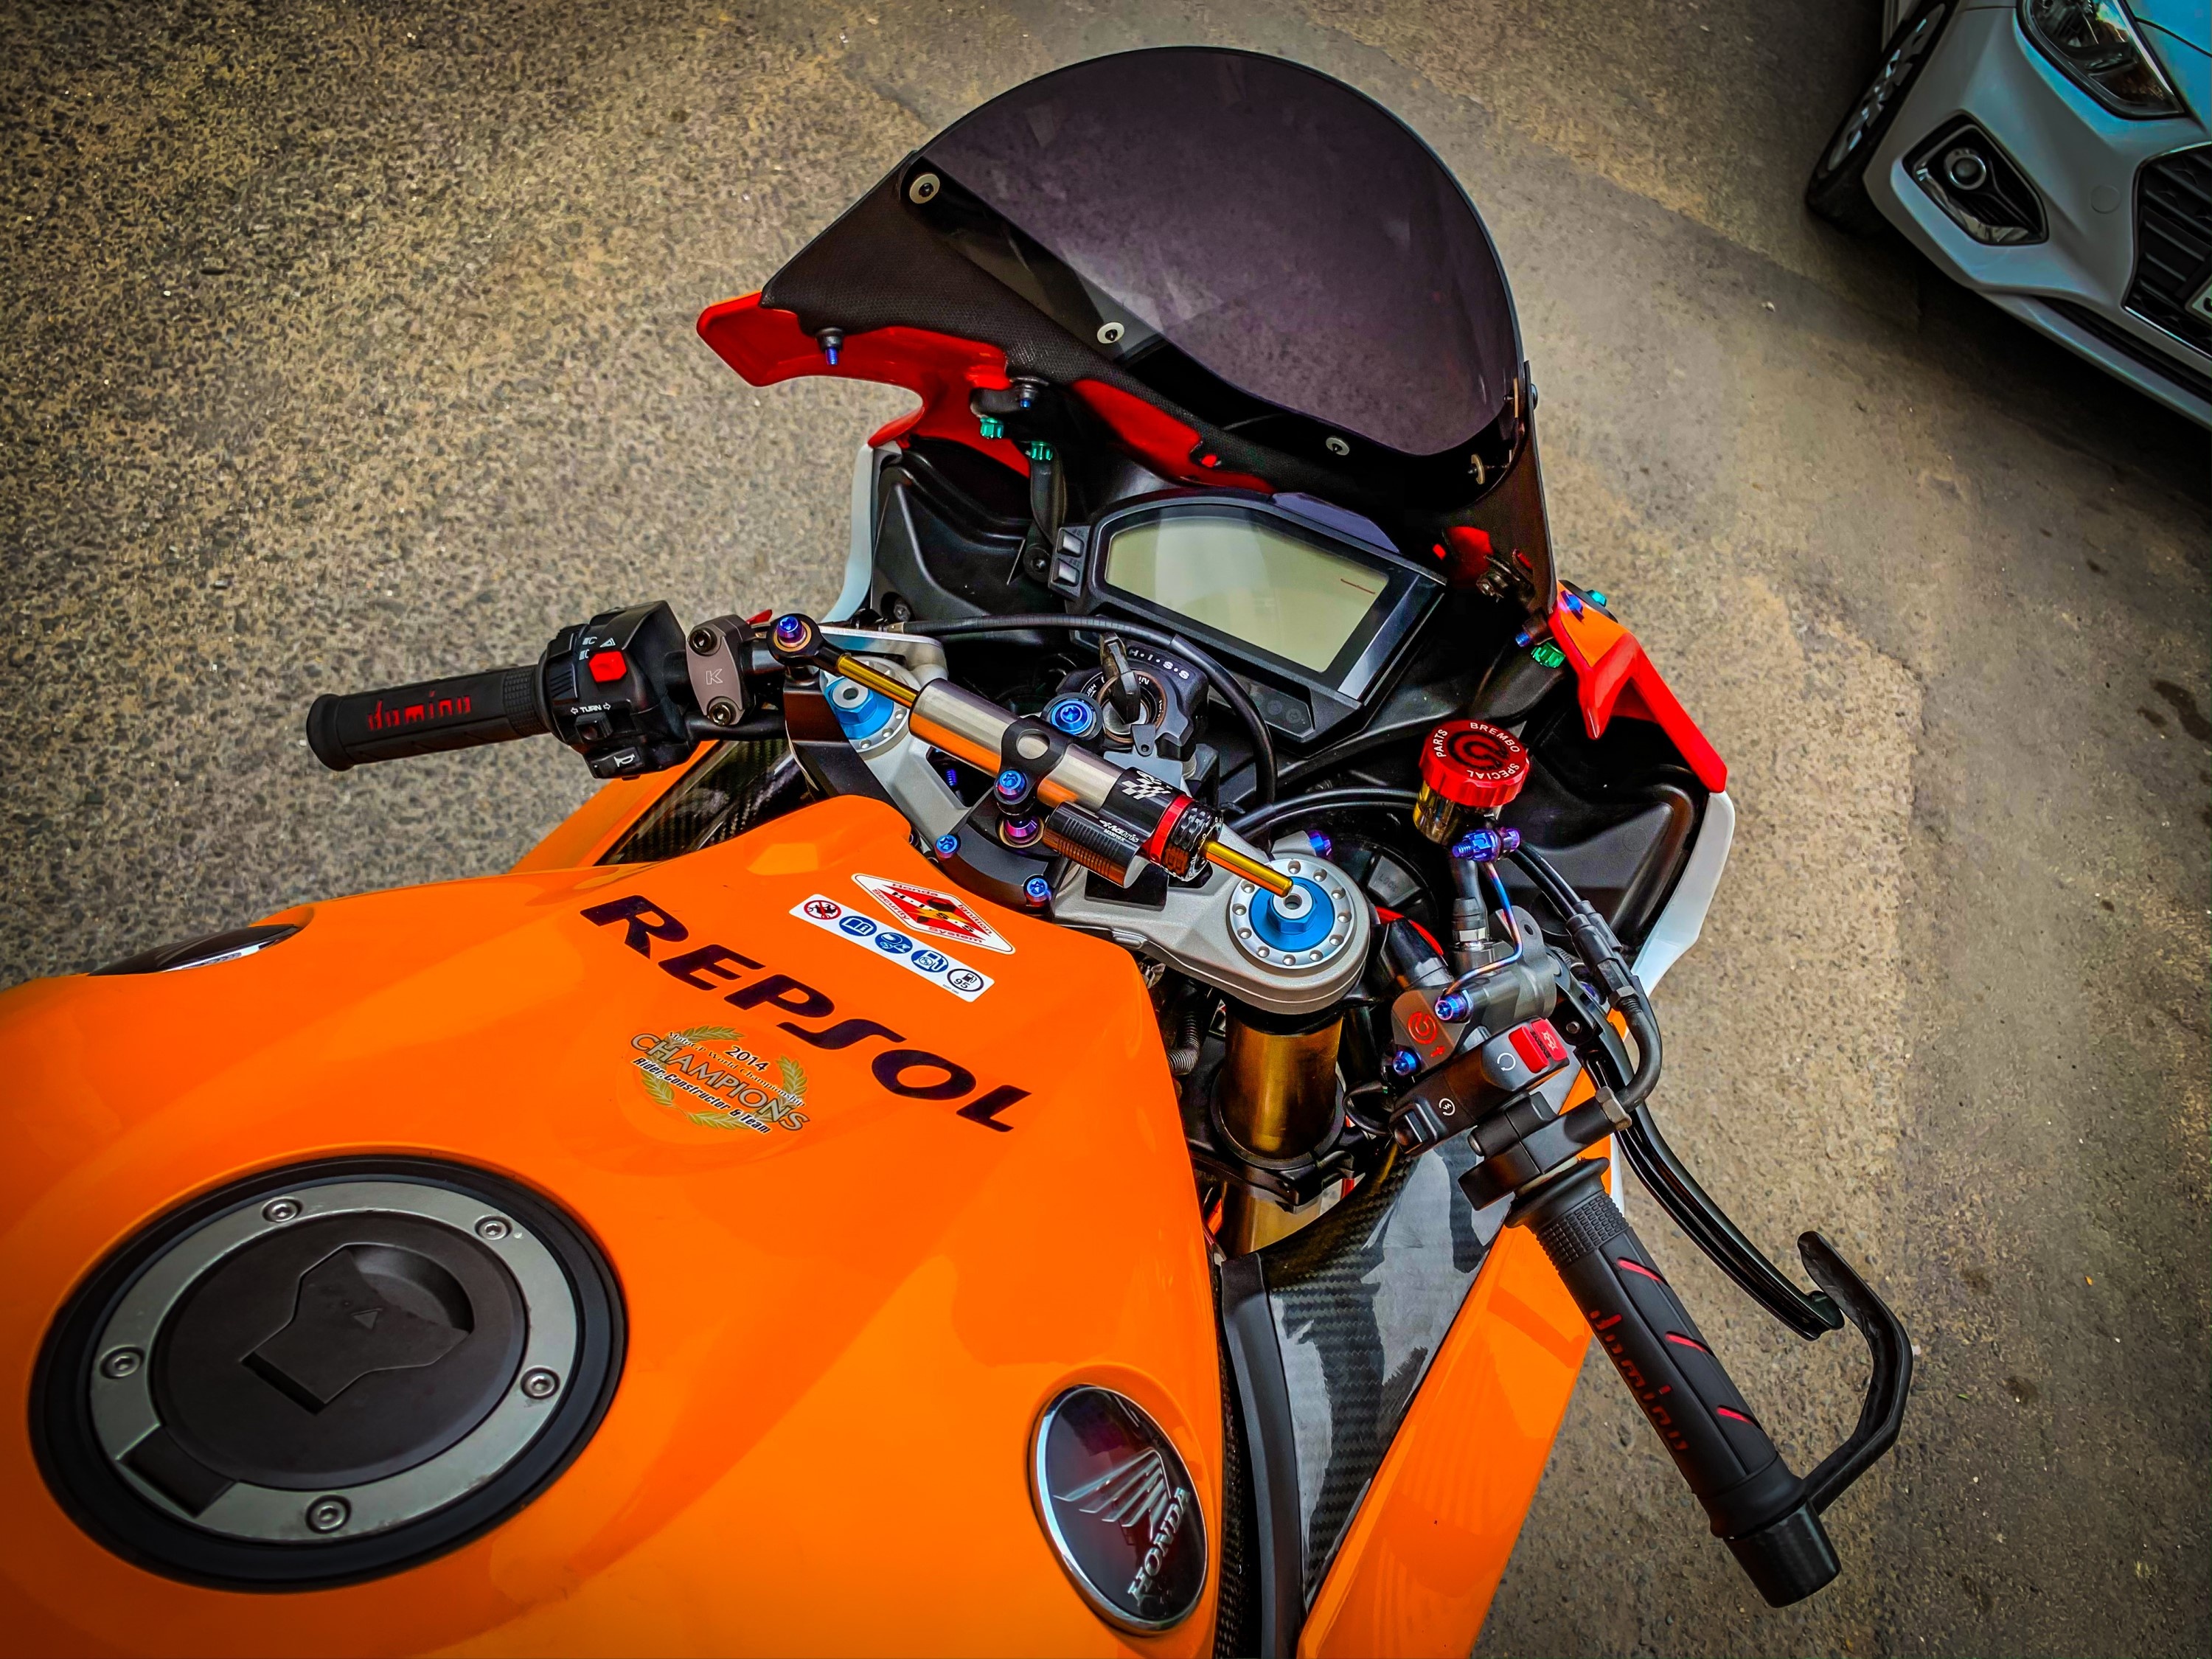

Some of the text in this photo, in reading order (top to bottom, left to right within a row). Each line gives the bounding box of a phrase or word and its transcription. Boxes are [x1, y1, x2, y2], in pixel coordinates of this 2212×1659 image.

[706, 668, 723, 686] K
[580, 703, 602, 713] TURN
[1433, 722, 1520, 780] BREMBO SPECIAL PARTS
[872, 888, 911, 921] Security
[892, 883, 939, 897] Honda
[959, 903, 993, 935] Ignition
[928, 926, 983, 943] System
[953, 978, 971, 989] 95
[580, 894, 1032, 1133] REPSOL
[668, 1032, 807, 1107] MotoGP World Championship
[726, 1046, 771, 1073] 2014
[631, 1033, 811, 1131] CHAMPIONS
[728, 1108, 742, 1118] &
[740, 1113, 771, 1134] Team
[1127, 1486, 1191, 1607] HONDA
